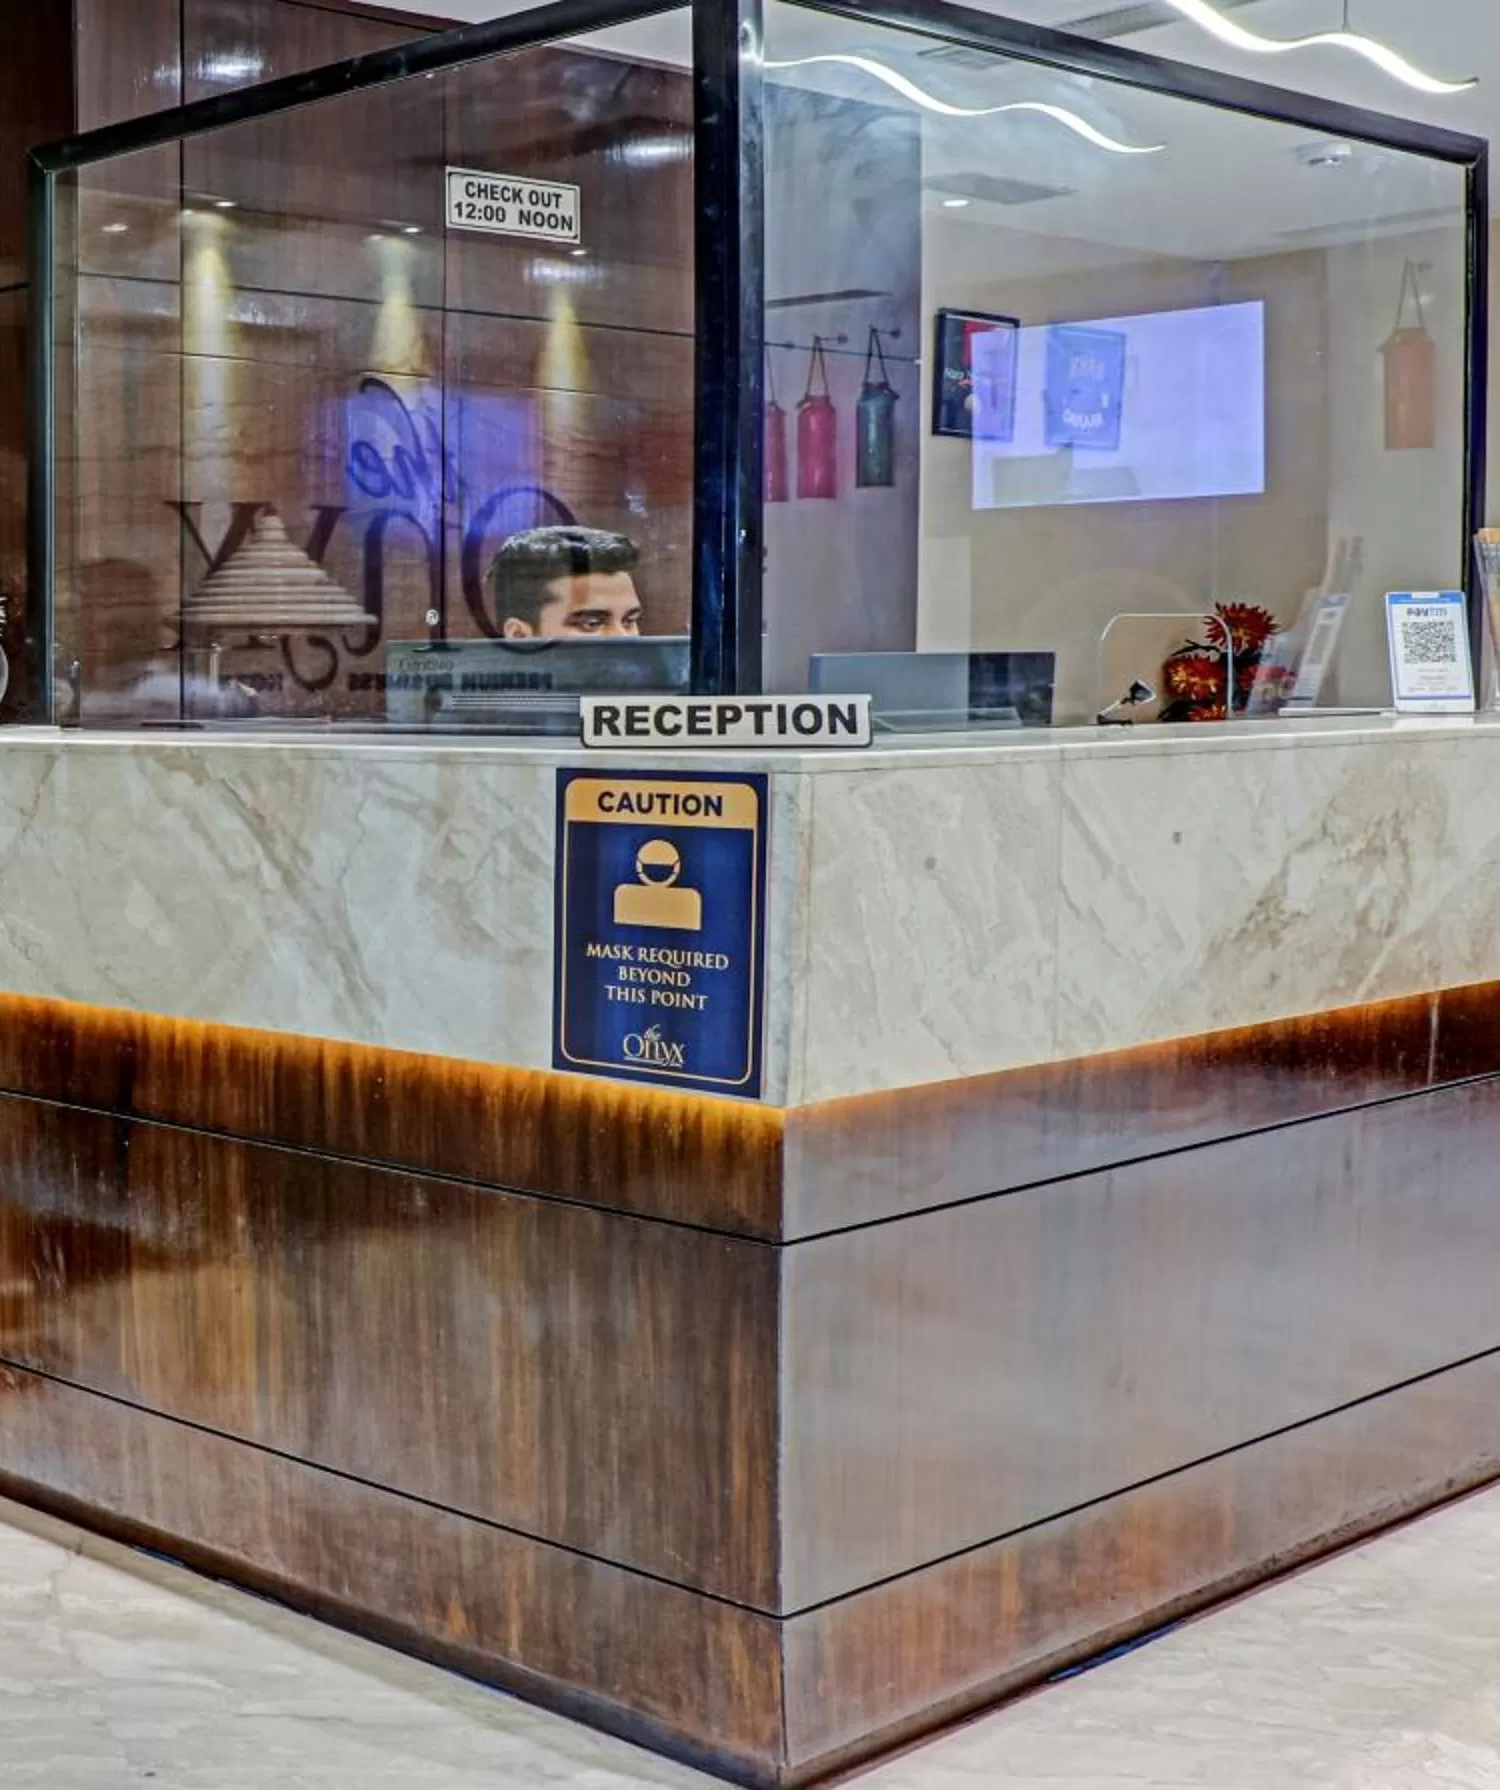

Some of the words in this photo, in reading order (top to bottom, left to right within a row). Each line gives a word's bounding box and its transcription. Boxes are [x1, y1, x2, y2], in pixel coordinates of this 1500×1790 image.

[465, 181, 523, 204] CHECK
[529, 189, 563, 209] OUT
[454, 201, 507, 223] 12:00
[518, 209, 573, 232] NOON
[592, 703, 858, 736] RECEPTION
[597, 790, 724, 817] CAUTION
[586, 943, 634, 961] MASK
[638, 947, 729, 970] REQUIRED
[618, 965, 691, 987] BEYOND
[604, 985, 645, 1004] THIS
[651, 990, 708, 1011] POINT
